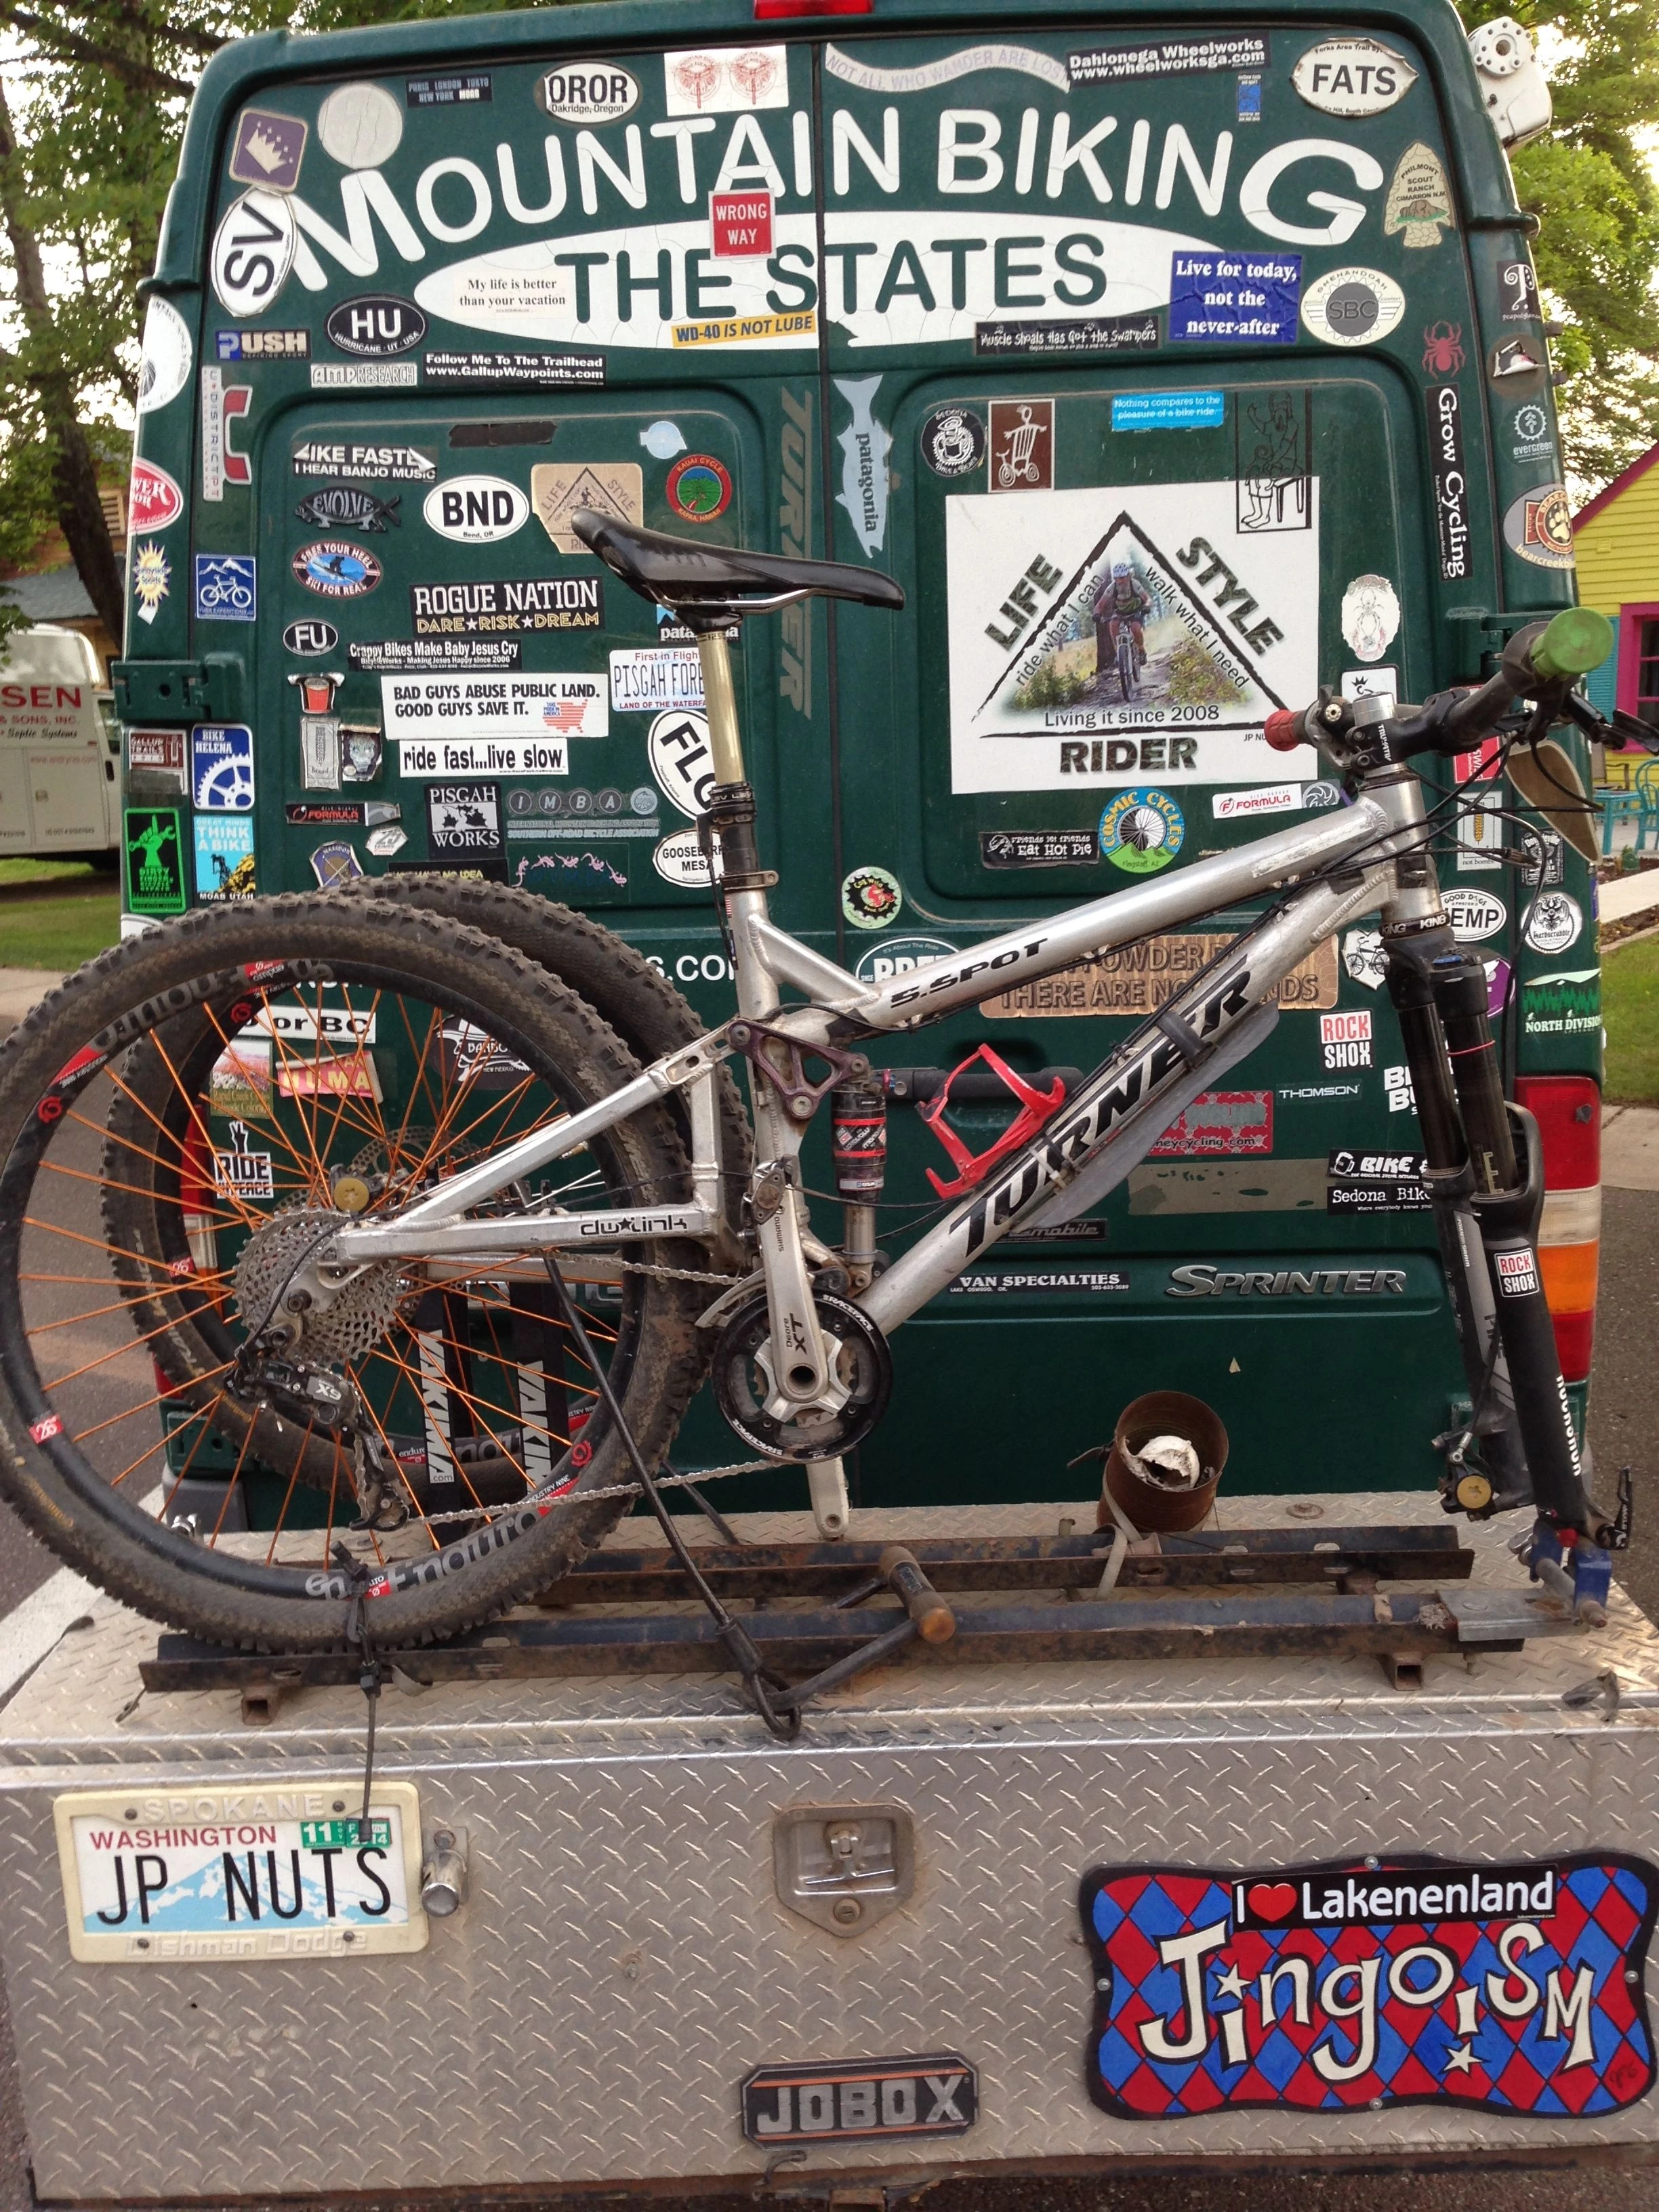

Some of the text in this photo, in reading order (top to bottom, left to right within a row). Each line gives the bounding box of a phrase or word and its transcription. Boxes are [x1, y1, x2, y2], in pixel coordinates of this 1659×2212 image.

[1070, 38, 1264, 70] Dahlonega Wheelworks
[1071, 50, 1265, 80] www.wheelworksga.com
[826, 50, 993, 90] NOT WHO WANDER
[1312, 64, 1397, 95] FATS
[548, 75, 628, 104] OROR
[594, 103, 623, 113] Oregon
[1407, 184, 1435, 193] RANCH
[1408, 176, 1434, 185] SCOUT
[291, 106, 1384, 291] MOUNTAIN BIKING
[716, 202, 768, 222] WRONG
[727, 227, 757, 245] WAY
[223, 201, 285, 298] SV
[554, 232, 1107, 324] THE STATES
[1176, 260, 1297, 283] Live for today,
[1317, 270, 1389, 294] SHENANDOAH
[468, 278, 557, 292] My life is better
[459, 294, 566, 308] than your vacation
[1204, 291, 1265, 307] not the
[1328, 298, 1378, 320] SBC
[352, 309, 403, 337] HU
[676, 314, 813, 343] WD-40 IS NOT LUBE
[1187, 320, 1280, 336] never-after
[334, 331, 382, 353] HURRICANE
[426, 354, 603, 367] Follow Me To The Trailhead
[426, 367, 605, 381] www.GallupWaypoints.com
[1114, 397, 1204, 409] Nothing compares to
[1512, 441, 1553, 455] evergreen
[303, 464, 388, 478] HEAR BANJO
[855, 432, 880, 533] patagonia
[1438, 387, 1470, 579] Grow Cycling
[313, 489, 374, 519] EVOLVE
[541, 478, 568, 511] LIFE
[607, 478, 637, 512] STYLE
[443, 491, 514, 527] BND
[324, 544, 375, 569] YOUR HEEL
[322, 582, 367, 596] FOR REAL
[414, 579, 598, 615] ROGUE NATION
[985, 536, 1285, 657] LIFE STYLE
[416, 611, 599, 634] DARE RISK DREAM
[1015, 566, 1250, 689] ride what can walk what need
[295, 624, 327, 649] FU
[350, 641, 518, 658] Crappy Bikes Make Baby Jesus Cry
[634, 651, 670, 661] First in
[394, 683, 601, 700] BAD GUYS ABUSE PUBLIC LAND.
[613, 663, 666, 698] PISGAH
[394, 701, 529, 718] GOOD GUYS SAVE IT.
[619, 701, 640, 710] LAND
[1044, 704, 1220, 729] Living it since 2008
[7, 726, 78, 740] Septic Systems
[202, 729, 226, 741] BIKE
[195, 741, 233, 754] HELENA
[404, 745, 436, 770] ride
[523, 743, 562, 768] slow
[1059, 736, 1198, 773] RIDER
[430, 787, 497, 803] PISGAH
[1235, 794, 1292, 810] FORMULA
[1102, 791, 1181, 847] COSMIC CYCLES
[433, 830, 500, 847] WORKS
[1443, 893, 1466, 905] GOOD
[1002, 982, 1085, 1009] THERE
[1091, 980, 1145, 1007] ARE
[272, 1016, 371, 1035] or BC
[1323, 1015, 1370, 1042] ROCK
[1525, 1019, 1563, 1033] NORTH
[1324, 1041, 1372, 1069] SHOX
[1278, 1084, 1360, 1099] THOMSON
[218, 1155, 269, 1181] RIDE
[1360, 1155, 1415, 1173] BIKE
[234, 1181, 270, 1196] PEACE
[1332, 1188, 1388, 1204] Sedona
[1500, 1254, 1534, 1274] ROCK
[959, 1274, 1121, 1288] VAN SPECIALTIES
[1166, 1265, 1407, 1297] SPRINTER
[1502, 1273, 1537, 1293] SHOX
[783, 1317, 794, 1348] Deore
[789, 1313, 808, 1355] LX
[142, 1793, 325, 1825] SPOKANE
[89, 1825, 277, 1851] WASHINGTON
[303, 1822, 333, 1843] 11
[96, 1846, 392, 1925] JP NUTS
[1237, 1870, 1555, 1923] I Lakenenland
[126, 1929, 367, 1958] Dishman Dodge
[756, 2074, 965, 2134] JOBOX
